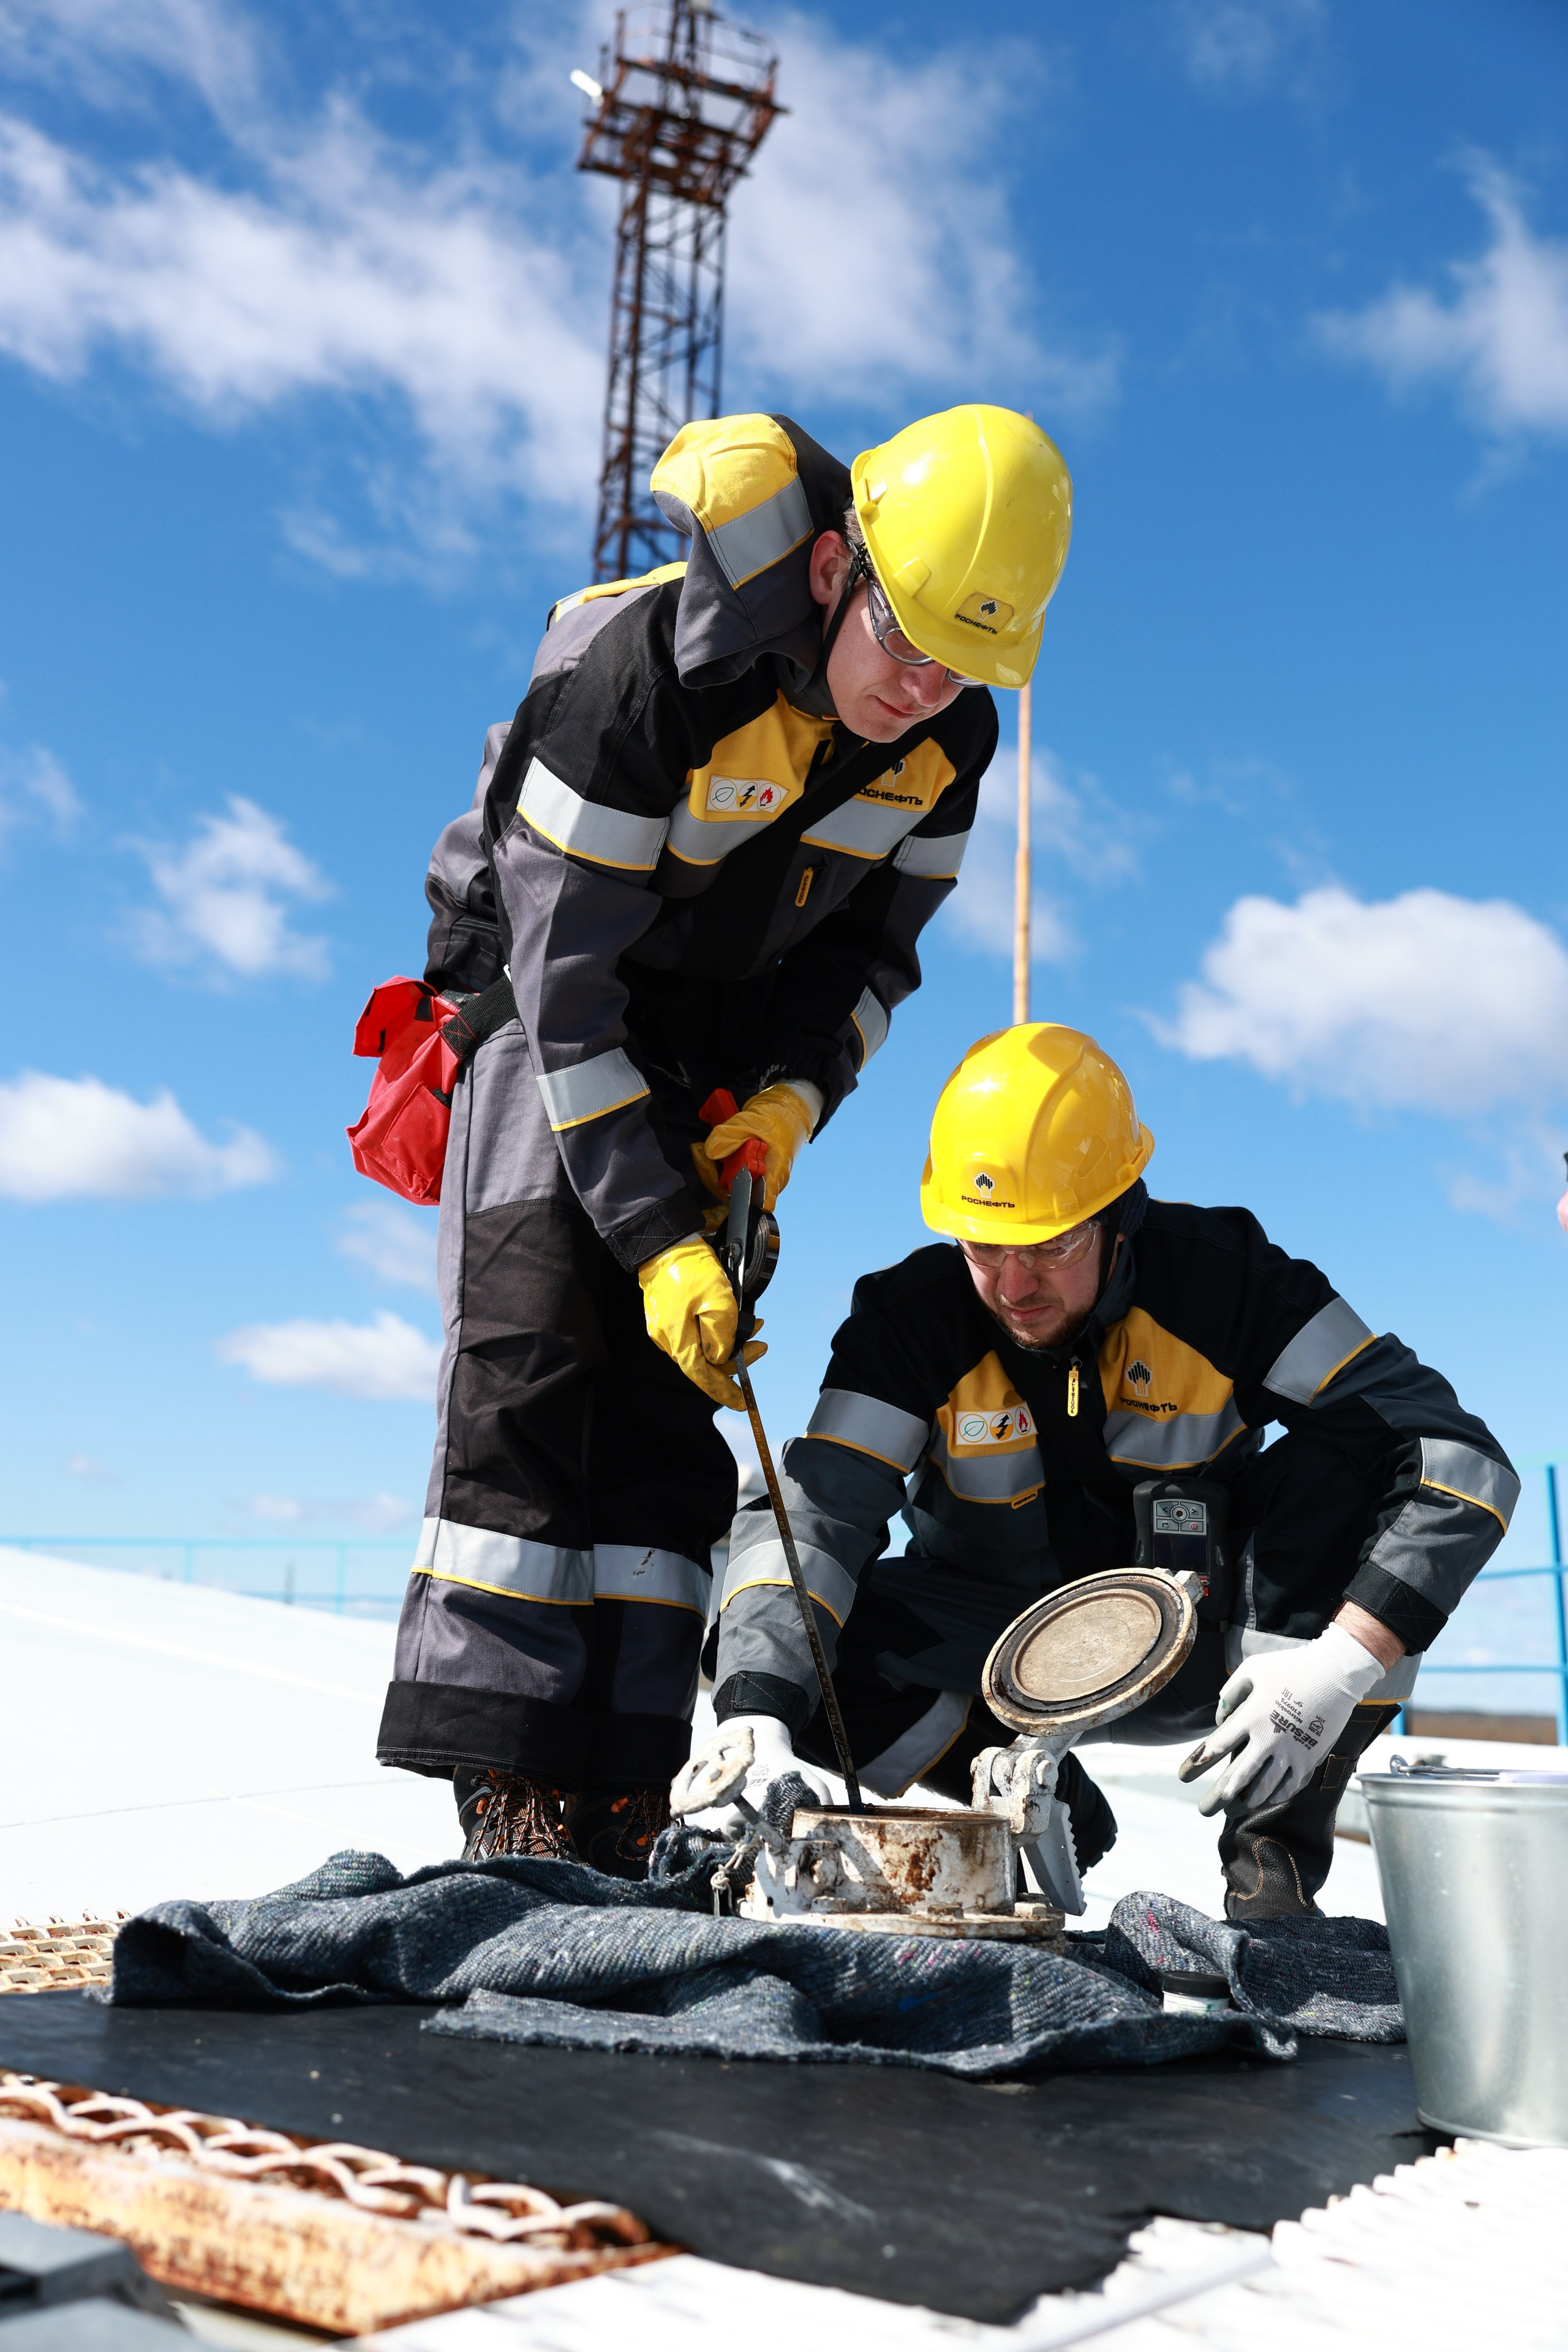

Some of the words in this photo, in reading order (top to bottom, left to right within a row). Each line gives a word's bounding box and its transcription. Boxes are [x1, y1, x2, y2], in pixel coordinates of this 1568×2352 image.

[955, 614, 997, 634] РОСНЕФТЬ
[797, 875, 809, 903] РОСНЕФТЬ
[961, 1195, 1015, 1207] РОСНЕФТЬ
[1275, 1700, 1303, 1724] Nitroskin
[1281, 1698, 1302, 1716] 210975
[1270, 1709, 1318, 1747] BESURE
[1293, 1735, 1305, 1745] safe
